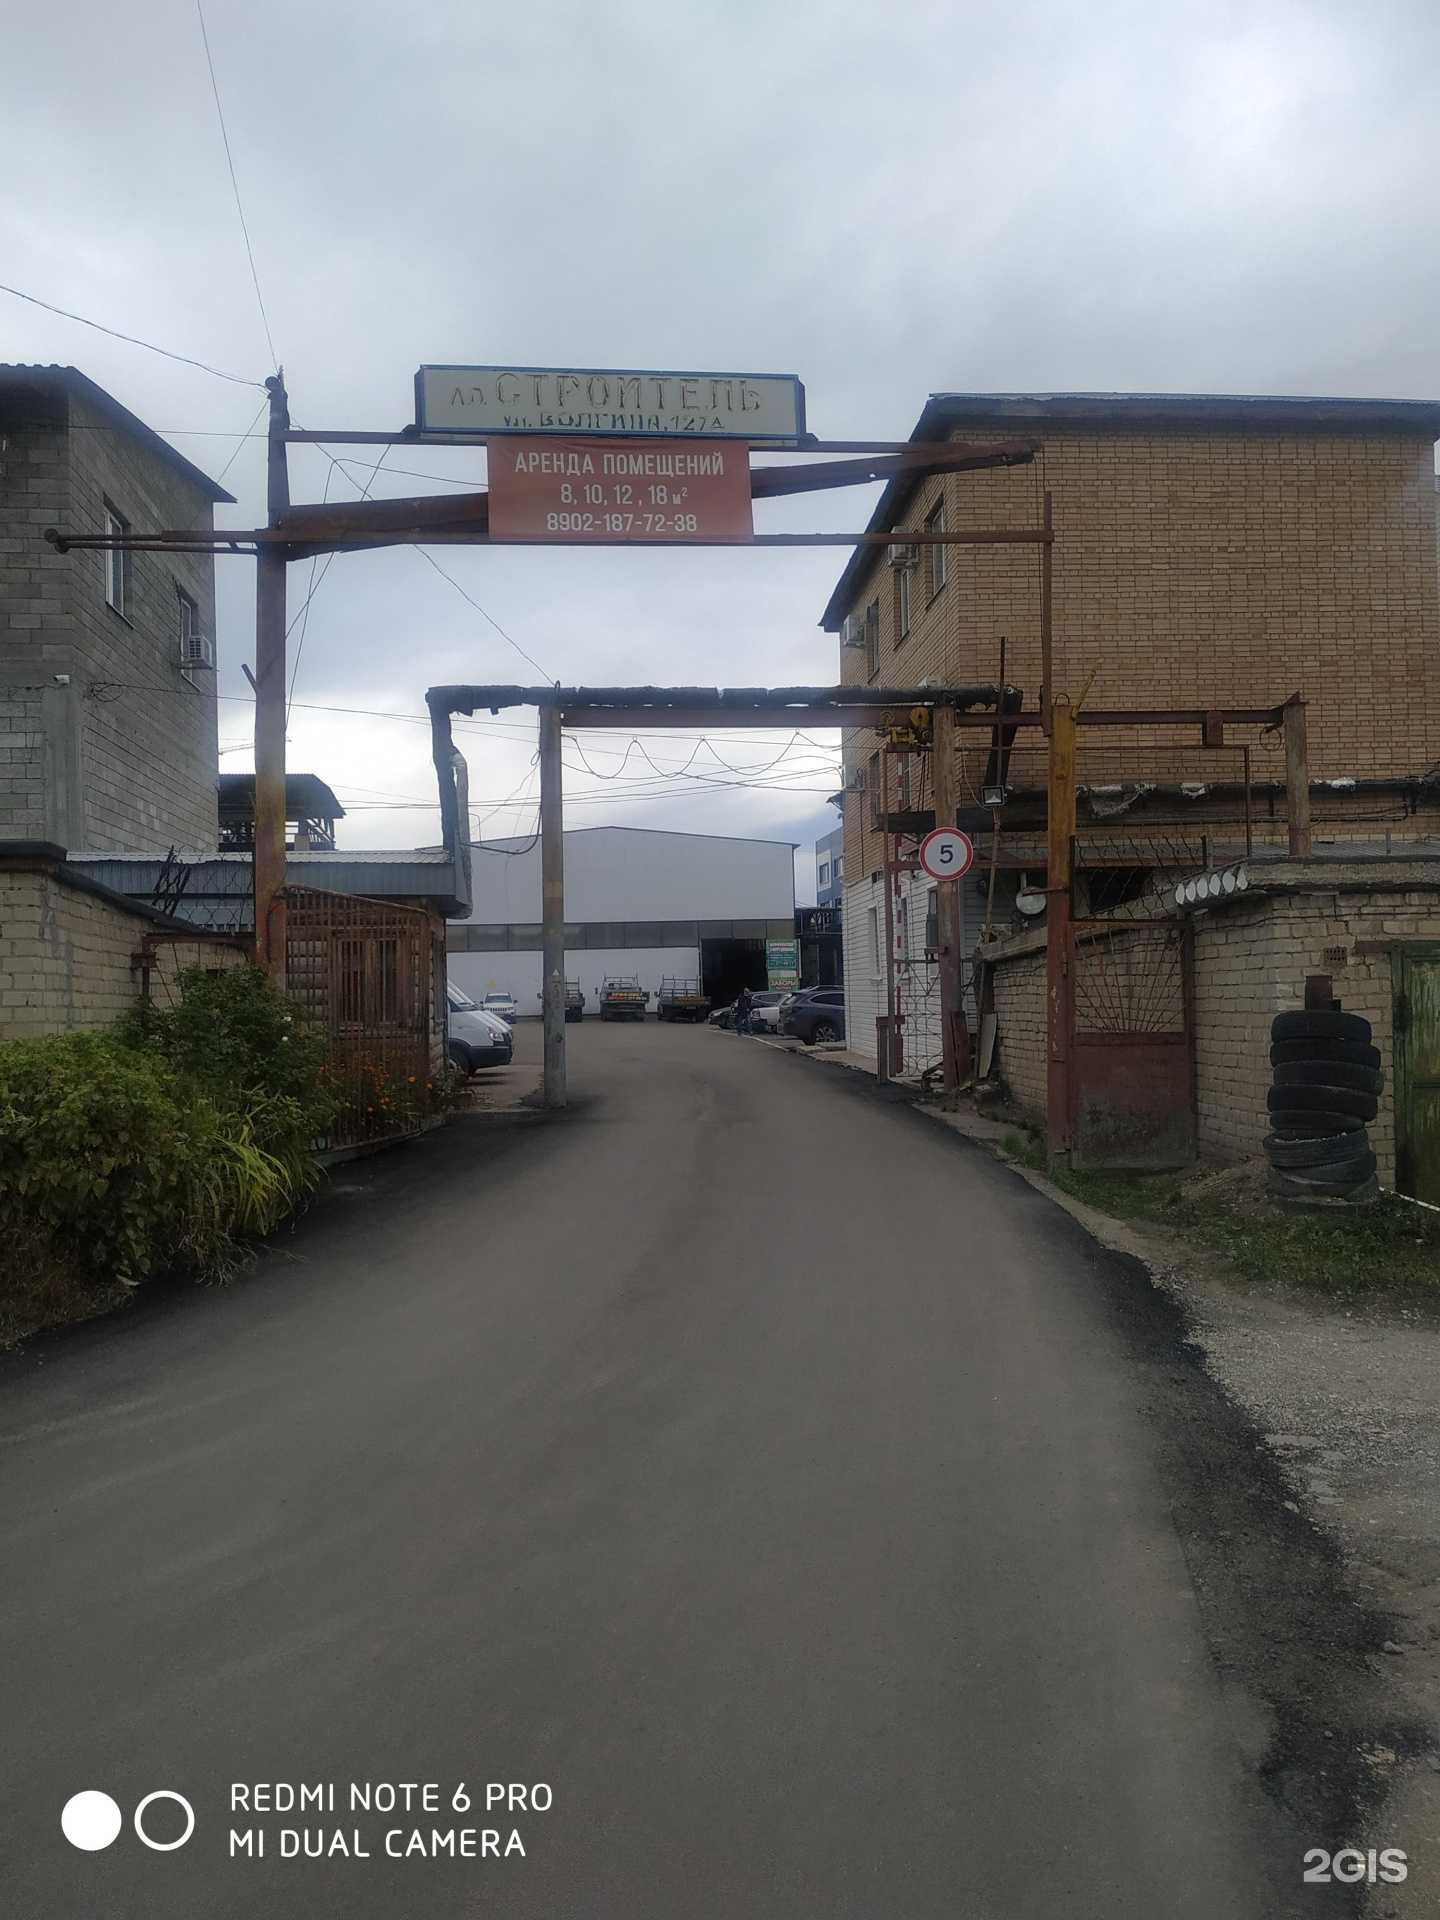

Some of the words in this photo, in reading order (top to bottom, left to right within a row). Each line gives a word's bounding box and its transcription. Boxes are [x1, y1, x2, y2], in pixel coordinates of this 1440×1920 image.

[496, 373, 761, 411] СТРОИТЕЛЬ
[515, 452, 595, 476] АРЕНДА
[603, 452, 725, 478] ПОМЕЩЕНИЙ
[584, 484, 608, 506] 10,
[546, 513, 697, 533] 8902-187-72-38
[939, 845, 954, 864] 5
